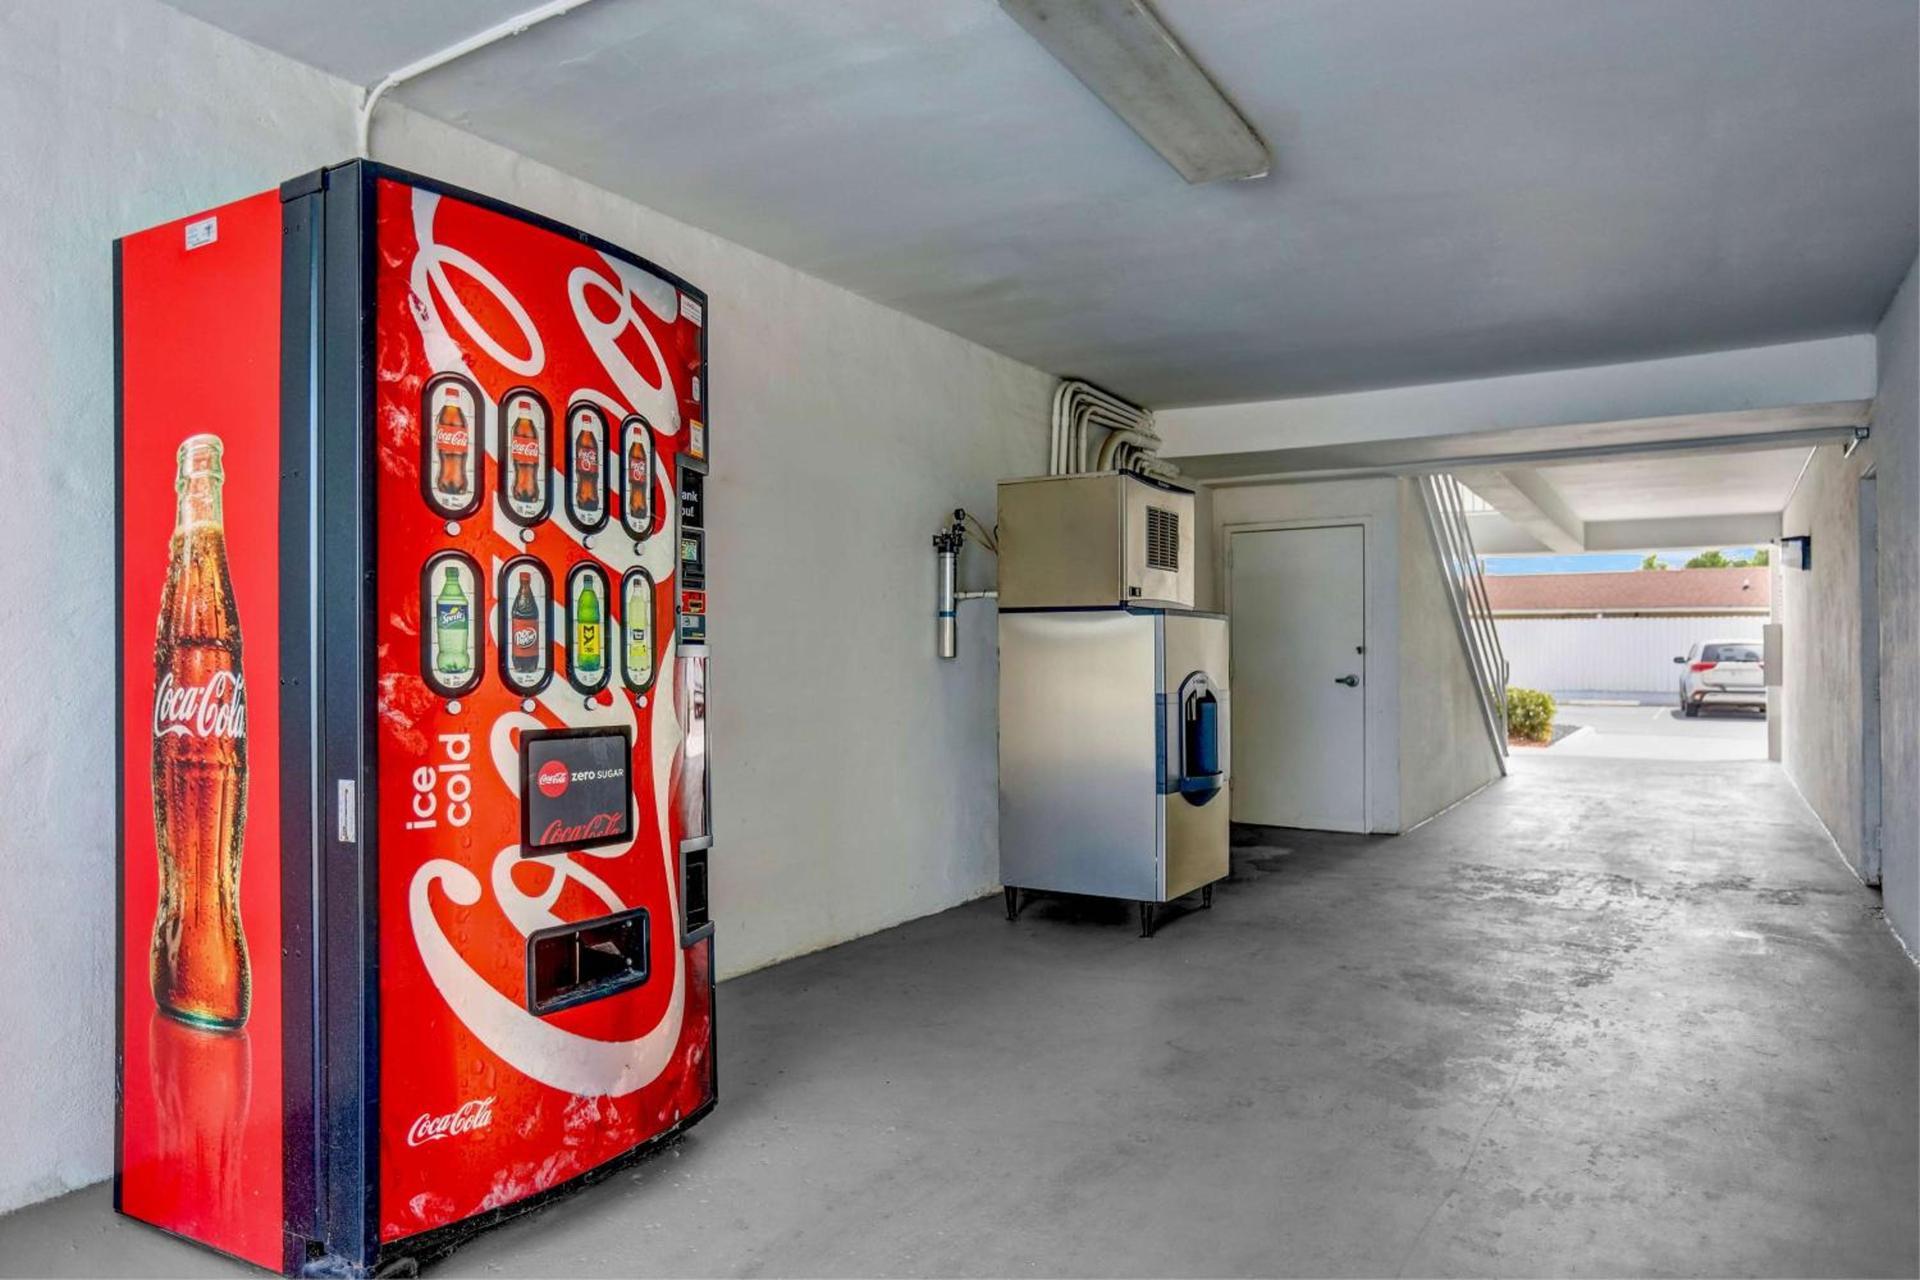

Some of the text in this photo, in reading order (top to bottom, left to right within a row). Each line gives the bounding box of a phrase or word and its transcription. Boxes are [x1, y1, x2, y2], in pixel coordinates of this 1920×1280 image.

[441, 611, 466, 624] Sprite
[153, 670, 244, 738] Coca-Cola
[406, 765, 437, 830] ice
[438, 733, 472, 827] cold
[571, 770, 596, 782] zero
[596, 768, 625, 779] SUGAR
[407, 1095, 497, 1147] Coca-Cola
